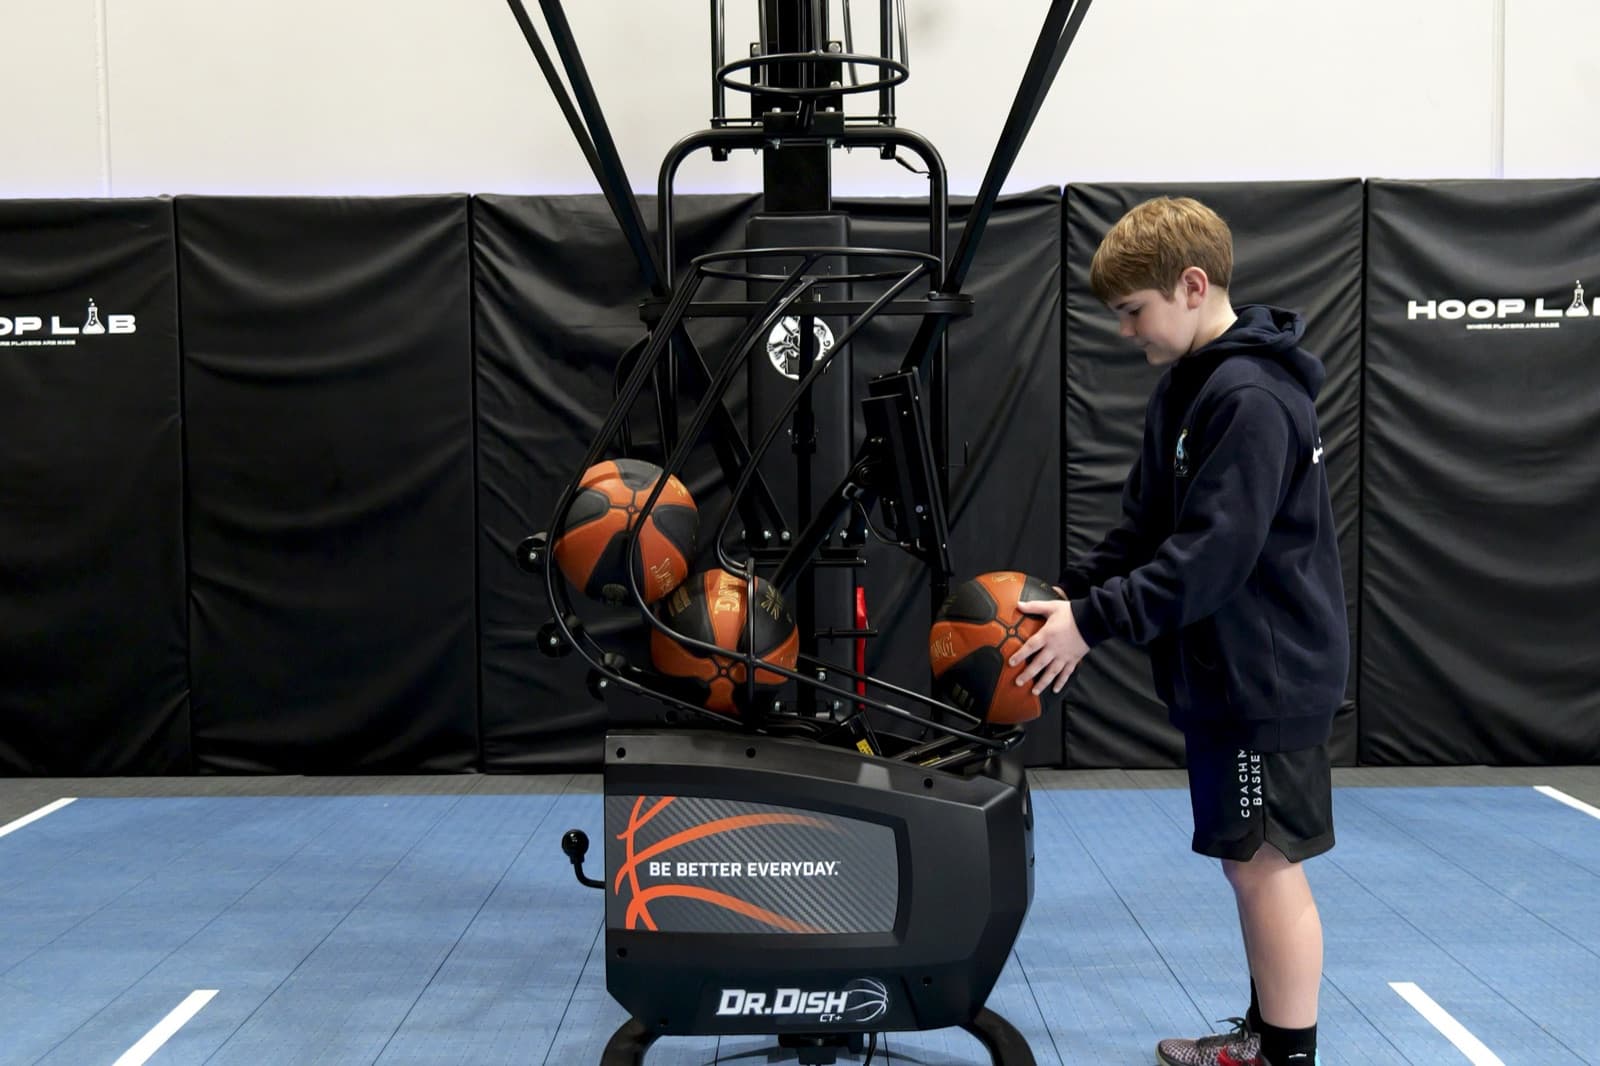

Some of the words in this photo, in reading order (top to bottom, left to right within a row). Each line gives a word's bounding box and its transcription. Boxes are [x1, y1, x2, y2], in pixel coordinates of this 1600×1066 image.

[1407, 299, 1525, 320] HOOP
[1535, 279, 1600, 318] LA
[1250, 750, 1263, 806] BASKE
[649, 861, 672, 877] BE
[676, 861, 742, 877] BETTER
[819, 1013, 843, 1023] CT+
